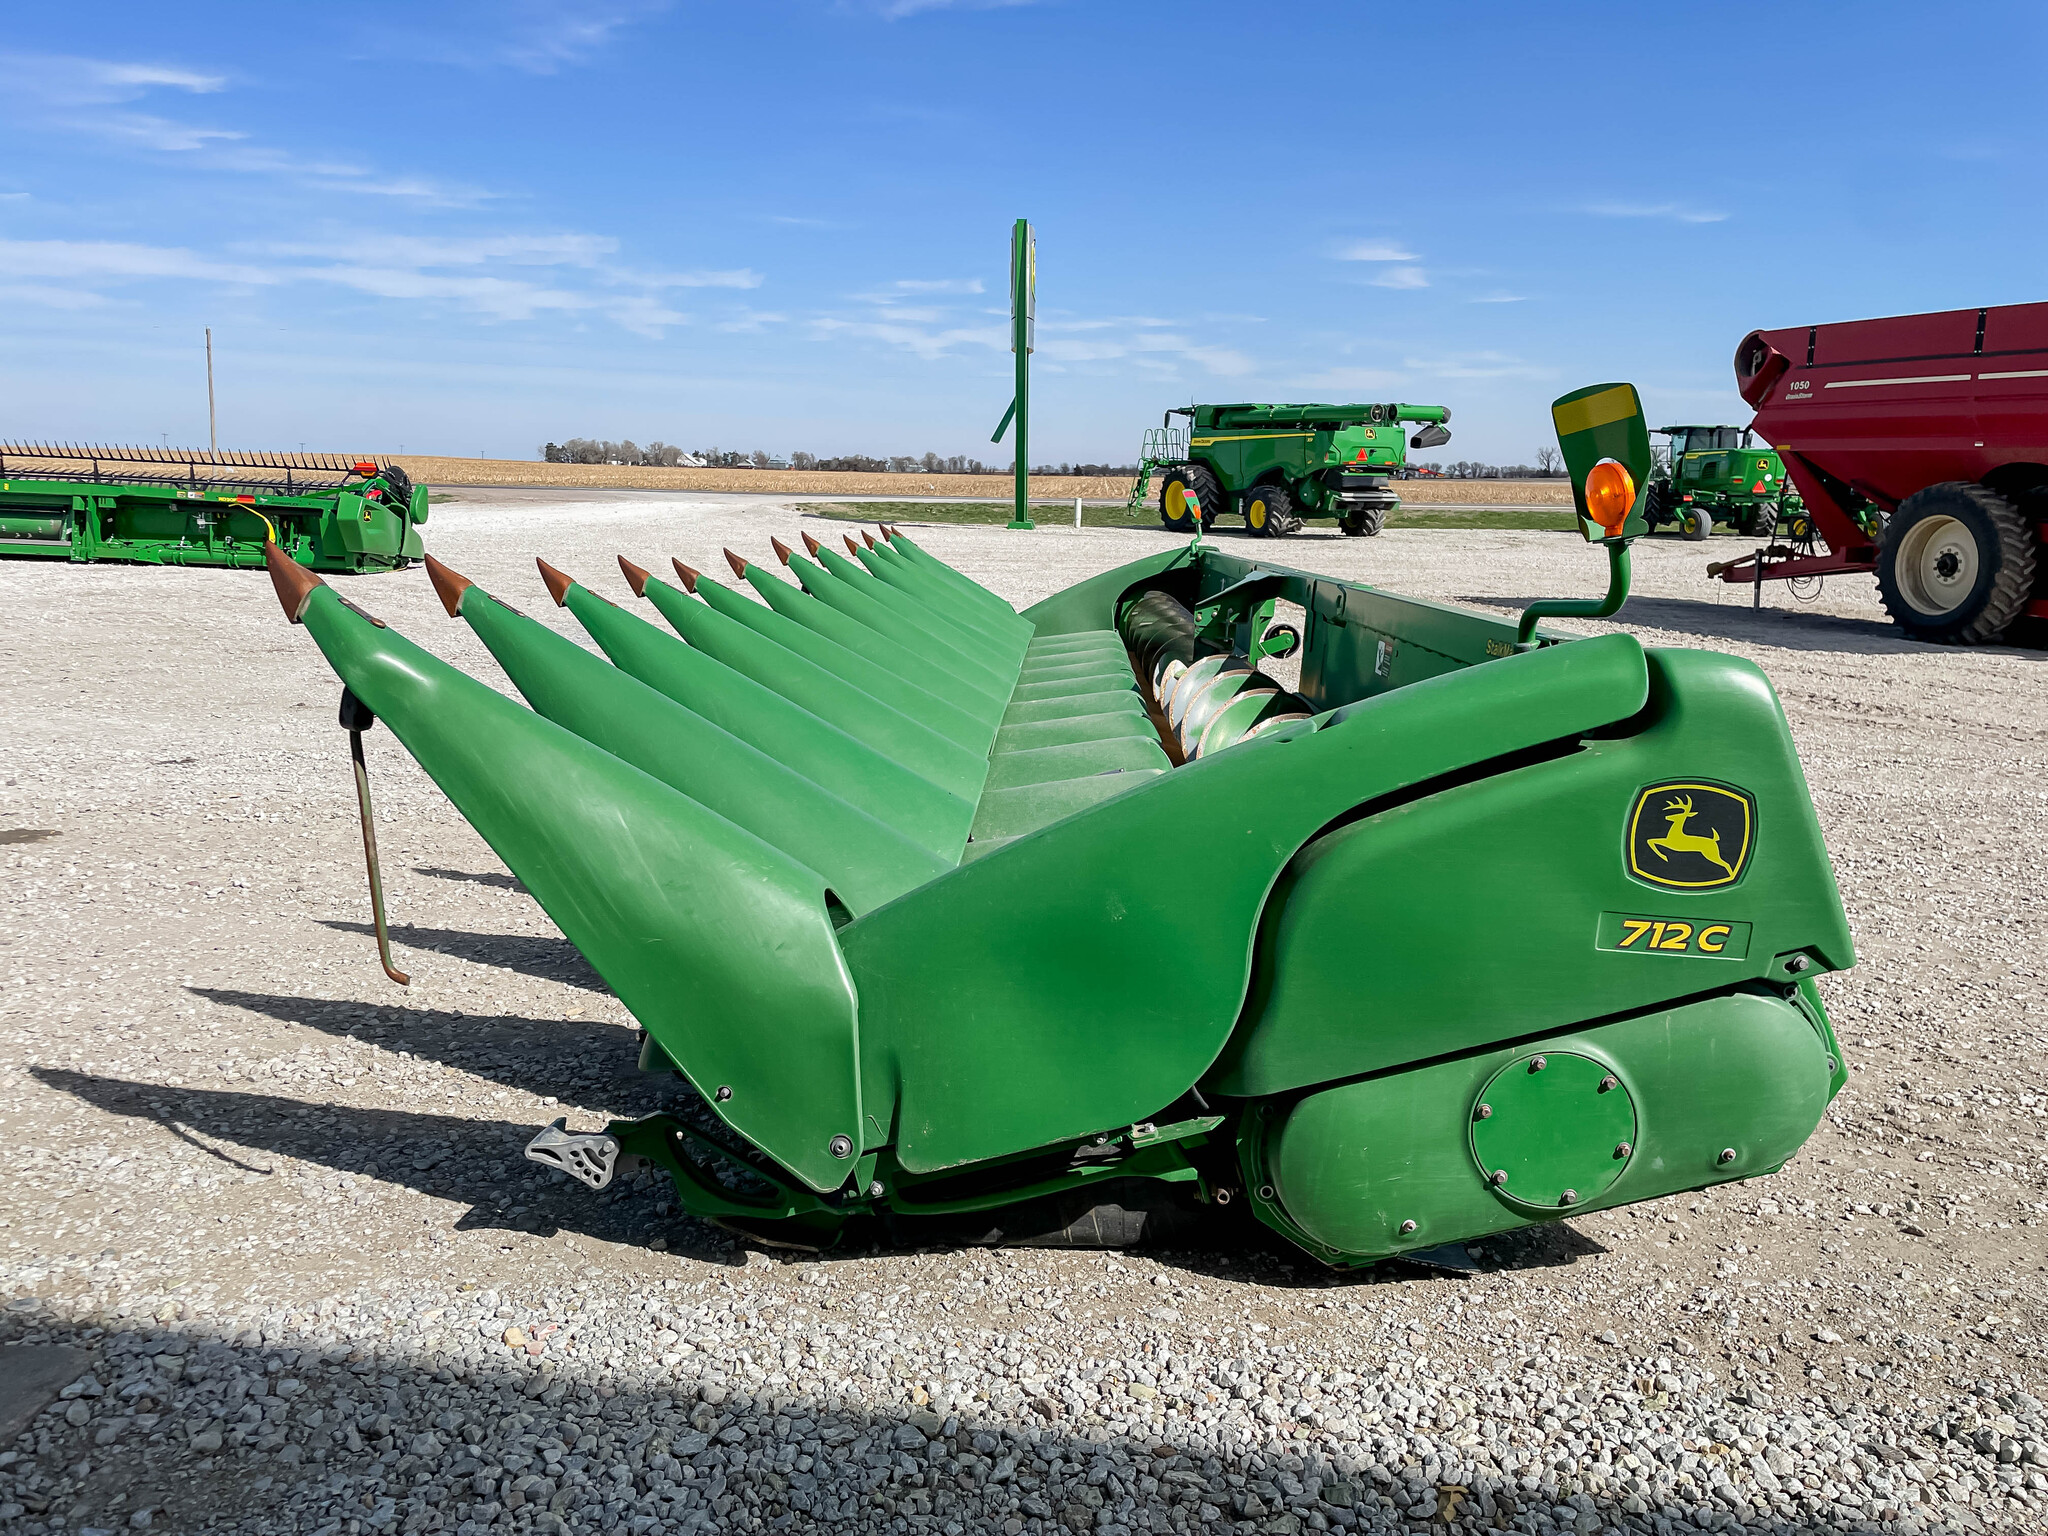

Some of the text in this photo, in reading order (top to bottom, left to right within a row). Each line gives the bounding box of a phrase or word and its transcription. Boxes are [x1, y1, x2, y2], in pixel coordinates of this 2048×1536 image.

[1790, 380, 1810, 391] 1050
[1616, 918, 1734, 954] 712 C
